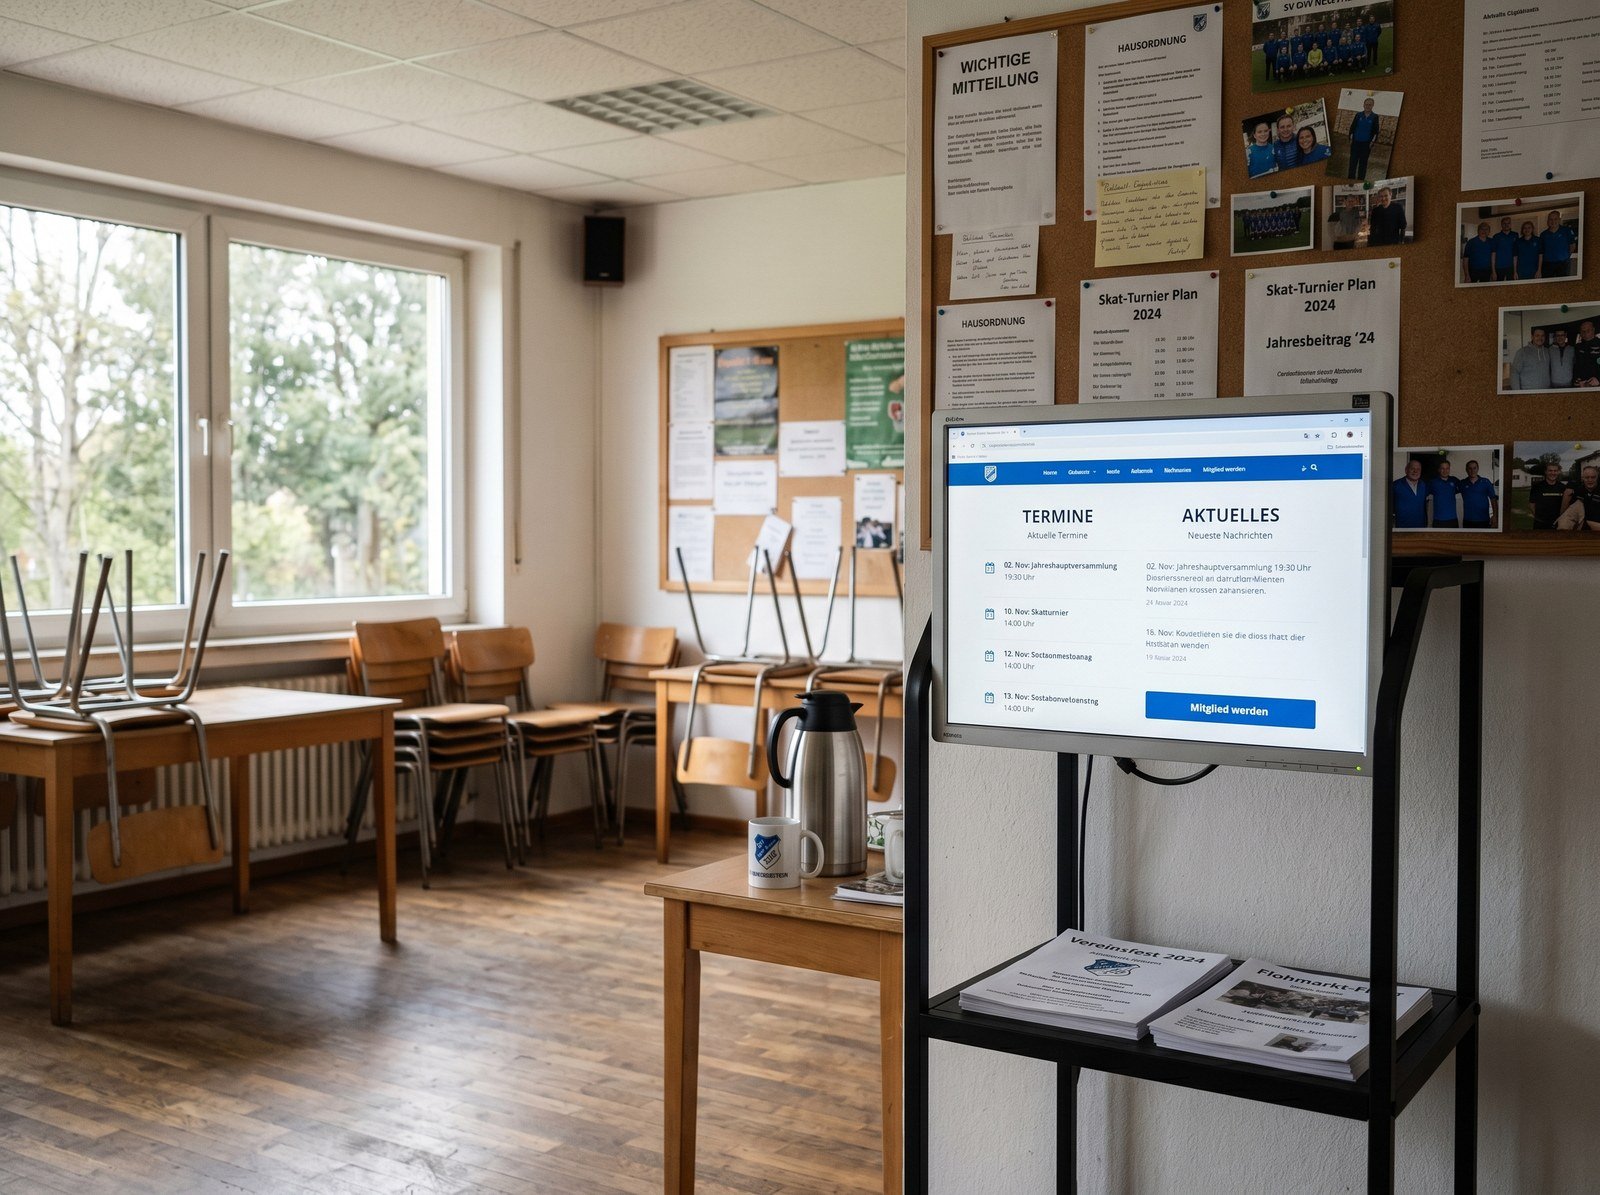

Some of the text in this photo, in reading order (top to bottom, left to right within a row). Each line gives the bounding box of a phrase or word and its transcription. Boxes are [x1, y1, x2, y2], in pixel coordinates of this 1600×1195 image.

[1284, 3, 1295, 11] SV
[1118, 35, 1187, 53] HAUSORDNUNG
[960, 51, 1031, 74] WICHTIGE
[952, 71, 1039, 95] MITTEILUNG
[1266, 278, 1376, 296] Skat-Turnier Plan
[1099, 288, 1198, 305] Skat-Turnier Plan
[1304, 299, 1336, 312] 2024
[1133, 308, 1162, 320] 2024
[962, 316, 1026, 328] HAUSORDNUNG
[1266, 334, 1351, 349] Jahresbeitrag
[1022, 509, 1093, 523] TERMINE
[1182, 507, 1280, 523] AKTUELLES
[1027, 531, 1088, 539] Aktuelle Termine
[1187, 531, 1273, 540] Neueste Nachrichten
[1004, 561, 1014, 569] 02.
[1031, 562, 1118, 572] Jahreshauptversammlung
[1176, 563, 1272, 573] Jahreshauptversammlung
[1274, 564, 1296, 572] 19:30
[1296, 564, 1312, 572] Uhr
[1031, 608, 1069, 617] Skatturnier
[1022, 705, 1035, 713] Uhr
[1190, 702, 1269, 717] Mitglied werden
[1070, 936, 1160, 958] Vereinsfest
[1163, 953, 1206, 964] 2024
